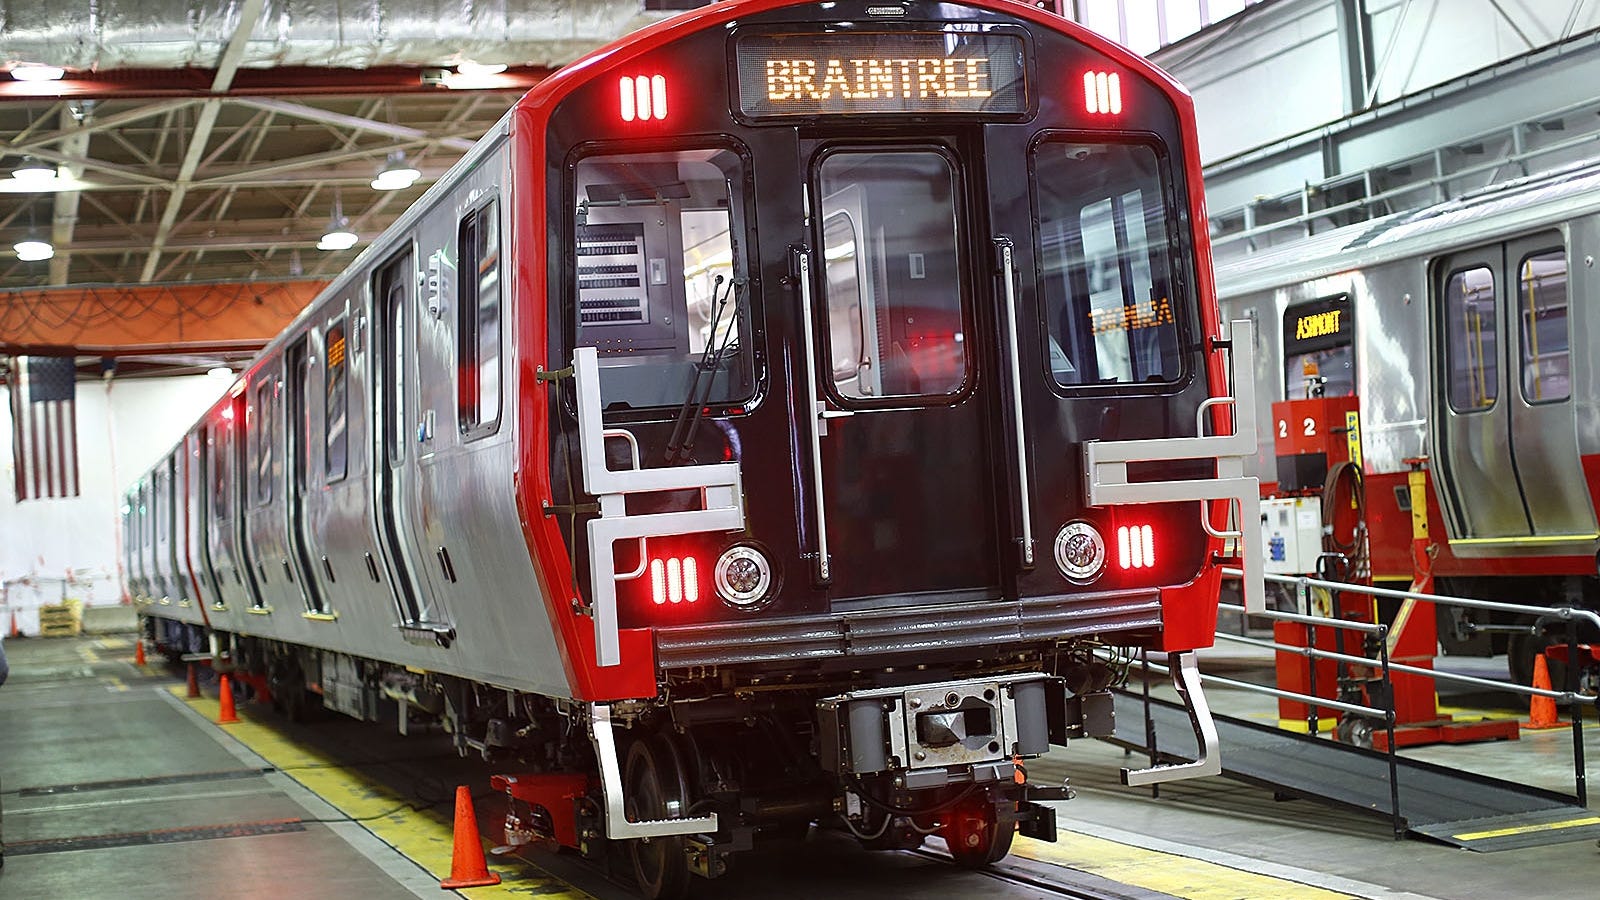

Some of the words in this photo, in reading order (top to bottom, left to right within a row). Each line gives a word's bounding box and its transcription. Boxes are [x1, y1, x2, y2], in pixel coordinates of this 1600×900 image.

[766, 58, 992, 100] BRAINTREE
[1295, 310, 1341, 340] ASHMONT
[1279, 419, 1288, 438] 2
[1303, 417, 1316, 436] 2
